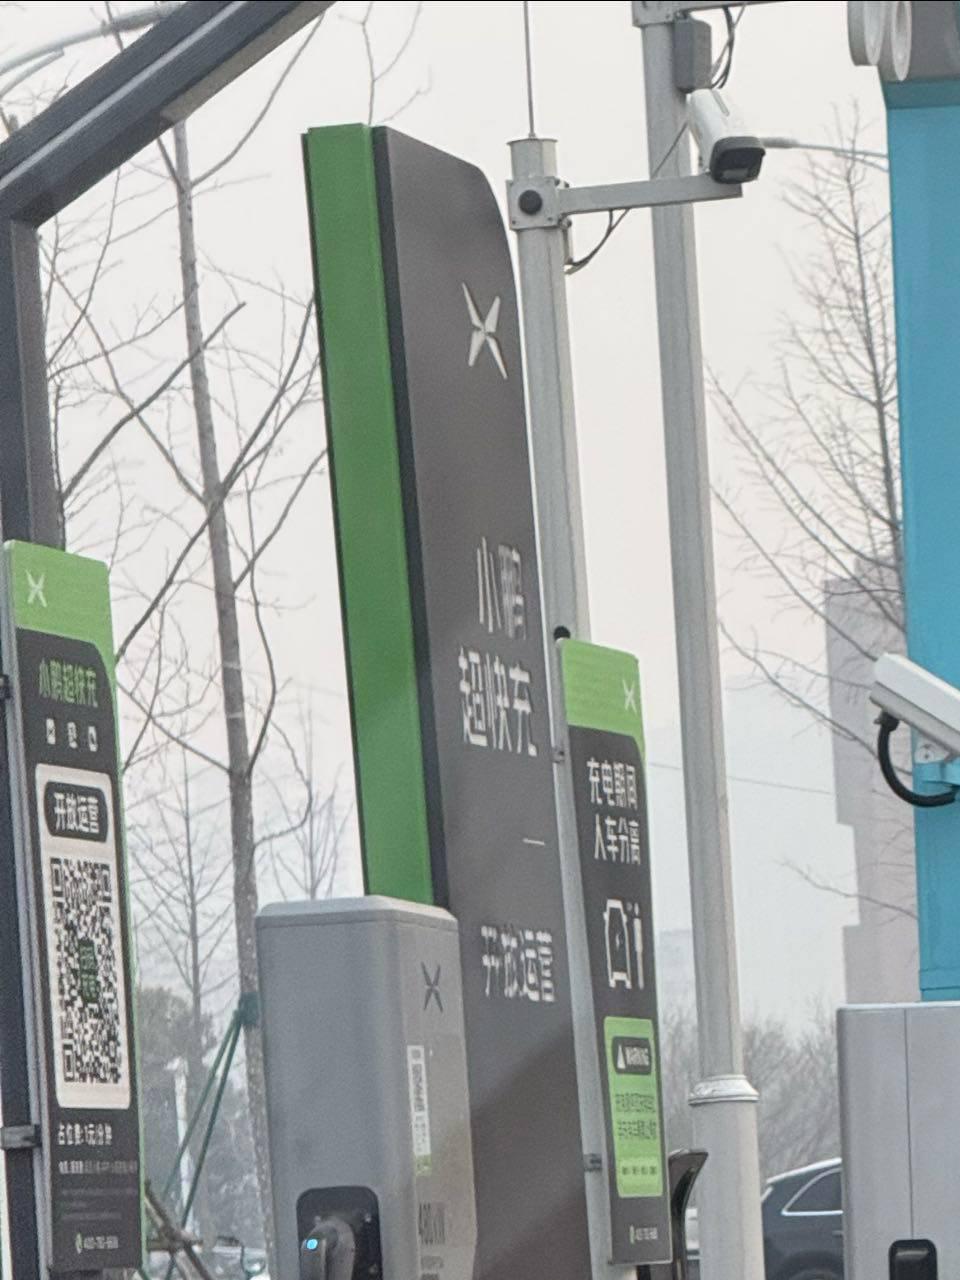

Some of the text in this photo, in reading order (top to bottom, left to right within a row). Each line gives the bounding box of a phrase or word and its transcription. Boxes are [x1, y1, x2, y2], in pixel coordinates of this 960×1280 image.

[458, 645, 537, 757] 超快充
[586, 757, 638, 811] 充电期间
[594, 813, 641, 865] 人车分离
[481, 926, 555, 1002] 开放运营
